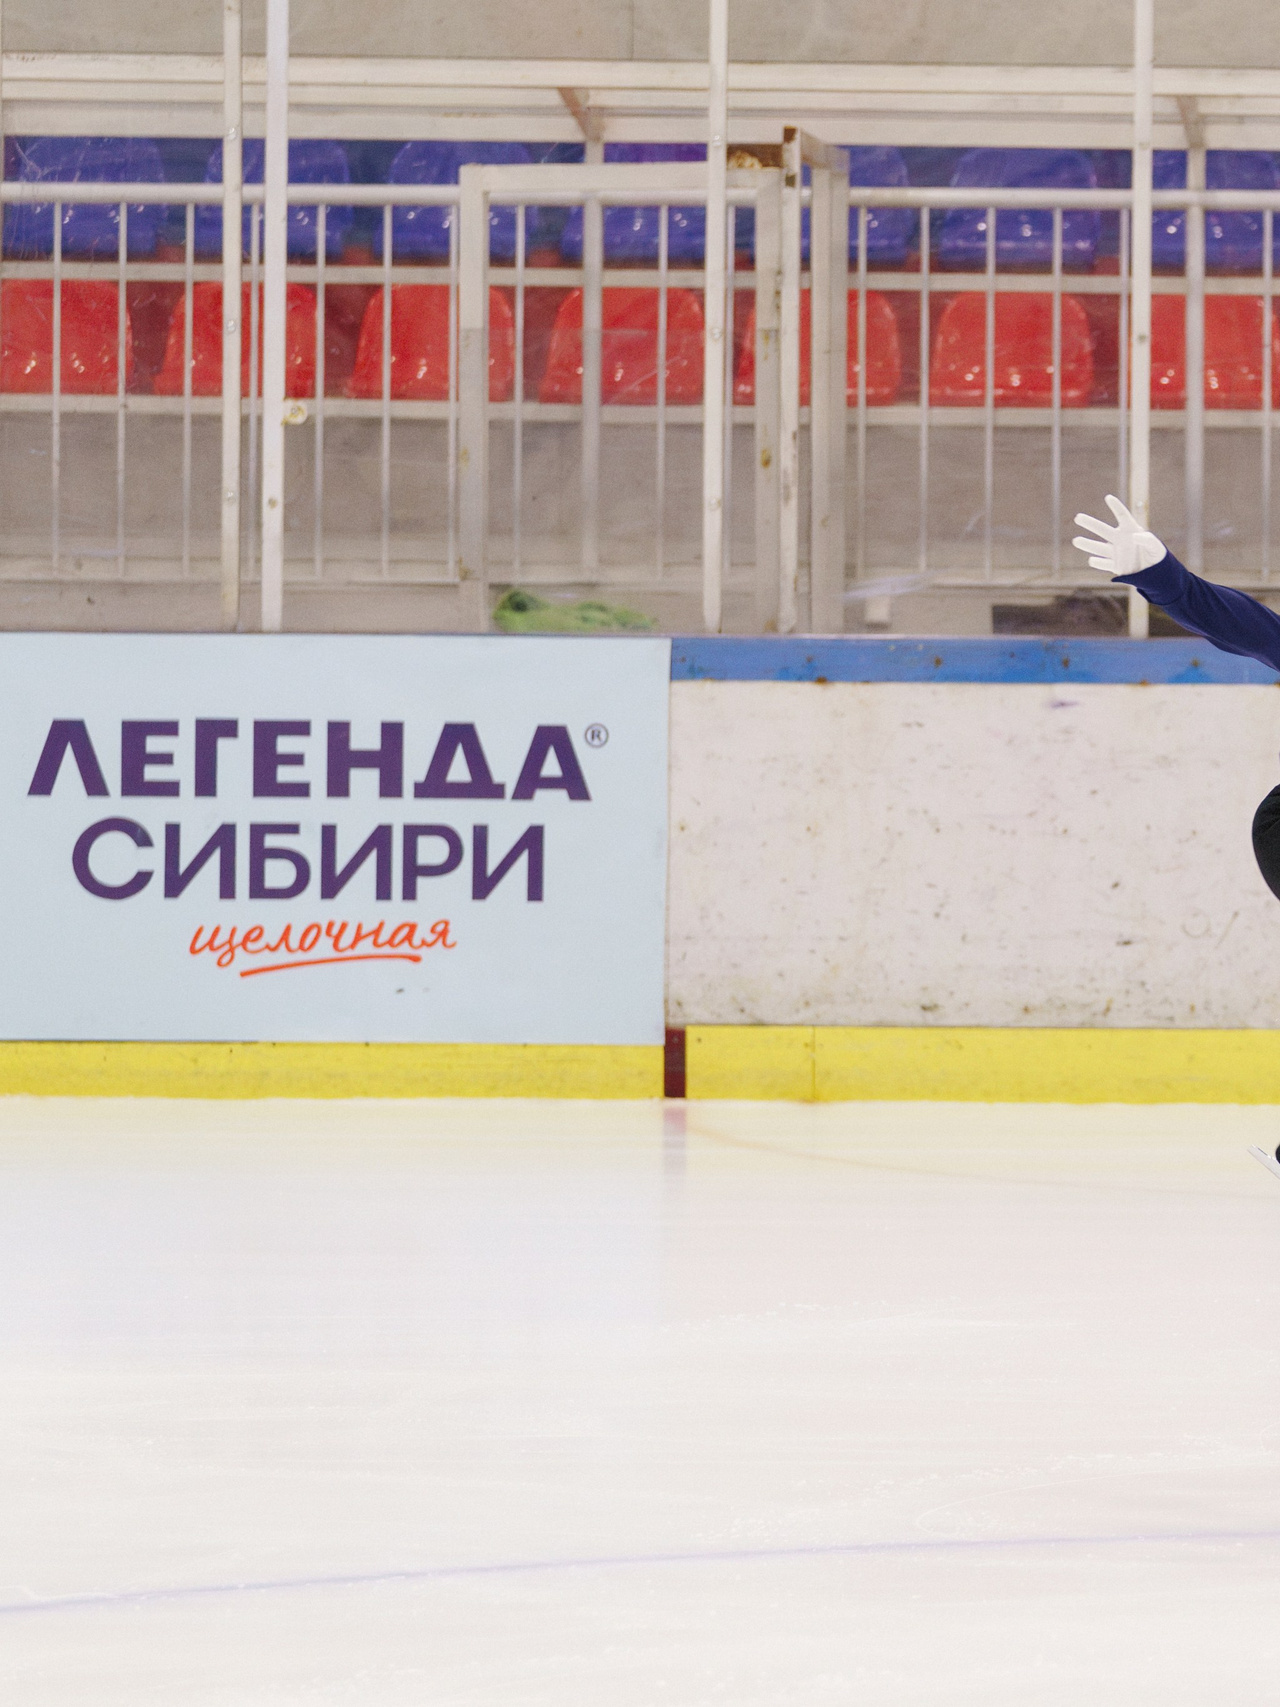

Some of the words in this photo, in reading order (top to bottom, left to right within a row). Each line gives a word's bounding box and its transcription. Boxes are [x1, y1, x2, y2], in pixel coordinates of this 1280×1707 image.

[27, 718, 592, 801] ЛЕГЕНДА
[72, 816, 545, 902] СИБИРИ
[189, 920, 457, 967] щелочная
